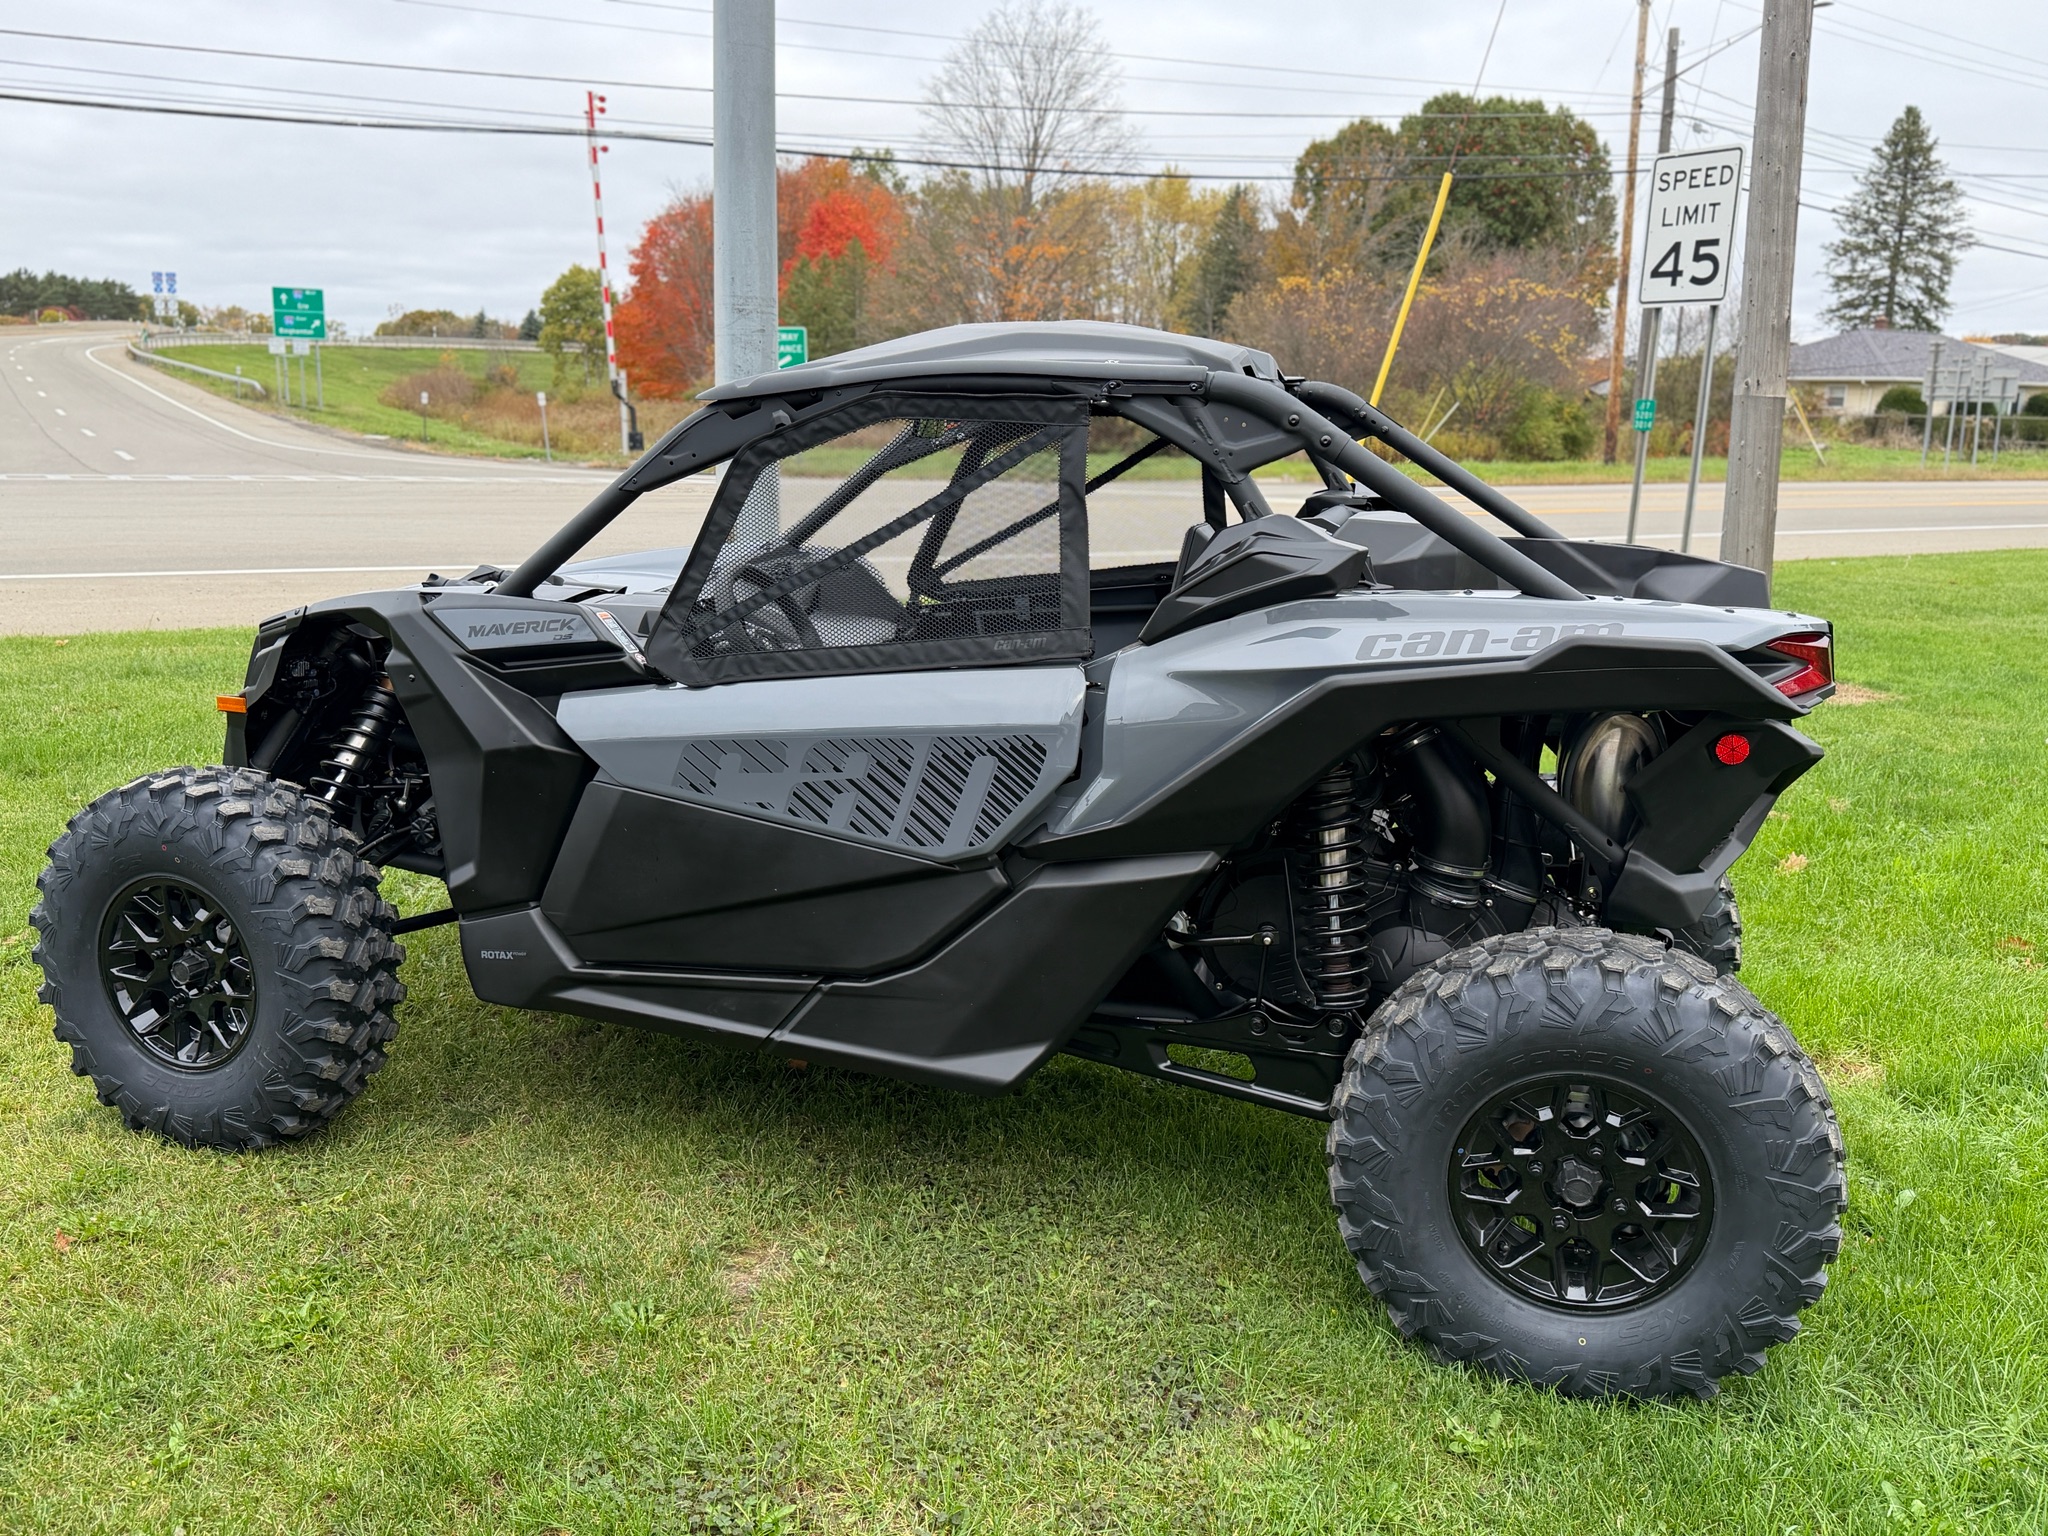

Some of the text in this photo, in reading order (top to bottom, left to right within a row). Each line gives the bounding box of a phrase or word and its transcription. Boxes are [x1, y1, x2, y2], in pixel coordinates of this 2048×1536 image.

[1658, 164, 1734, 192] SPEED
[1662, 202, 1721, 227] LIMIT
[1650, 238, 1720, 287] 45
[467, 617, 576, 638] MAVERICK
[552, 633, 574, 641] DS
[480, 950, 514, 960] ROTAX
